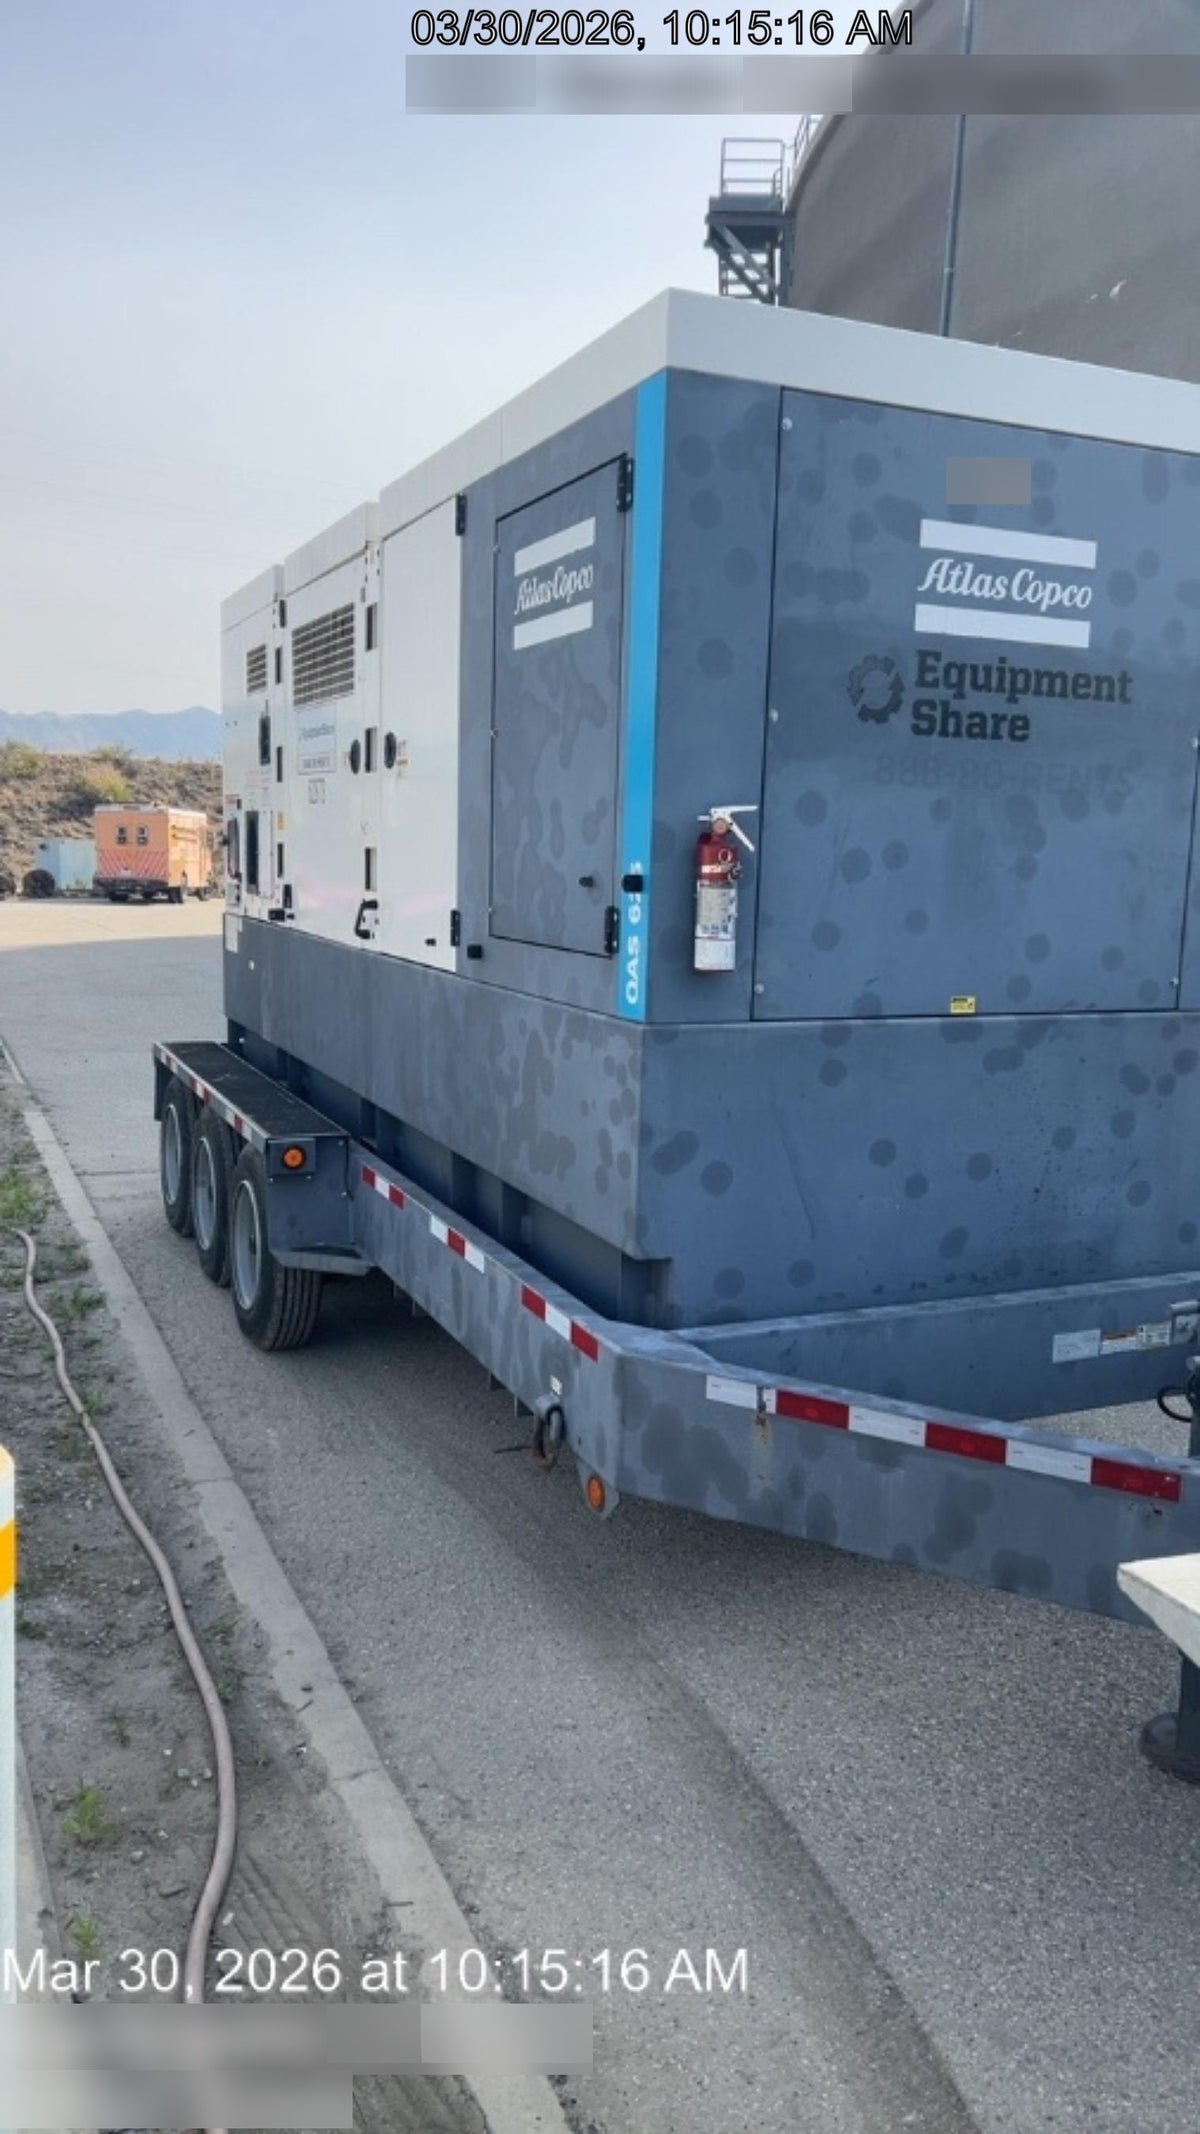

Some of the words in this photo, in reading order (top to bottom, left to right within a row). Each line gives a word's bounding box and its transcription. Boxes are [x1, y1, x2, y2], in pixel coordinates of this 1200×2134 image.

[513, 577, 552, 615] Atlas
[553, 564, 594, 604] Copco
[917, 557, 1009, 600] Atlas
[1012, 568, 1093, 612] Copco
[915, 650, 1133, 704] Equipment
[911, 698, 1031, 743] Share
